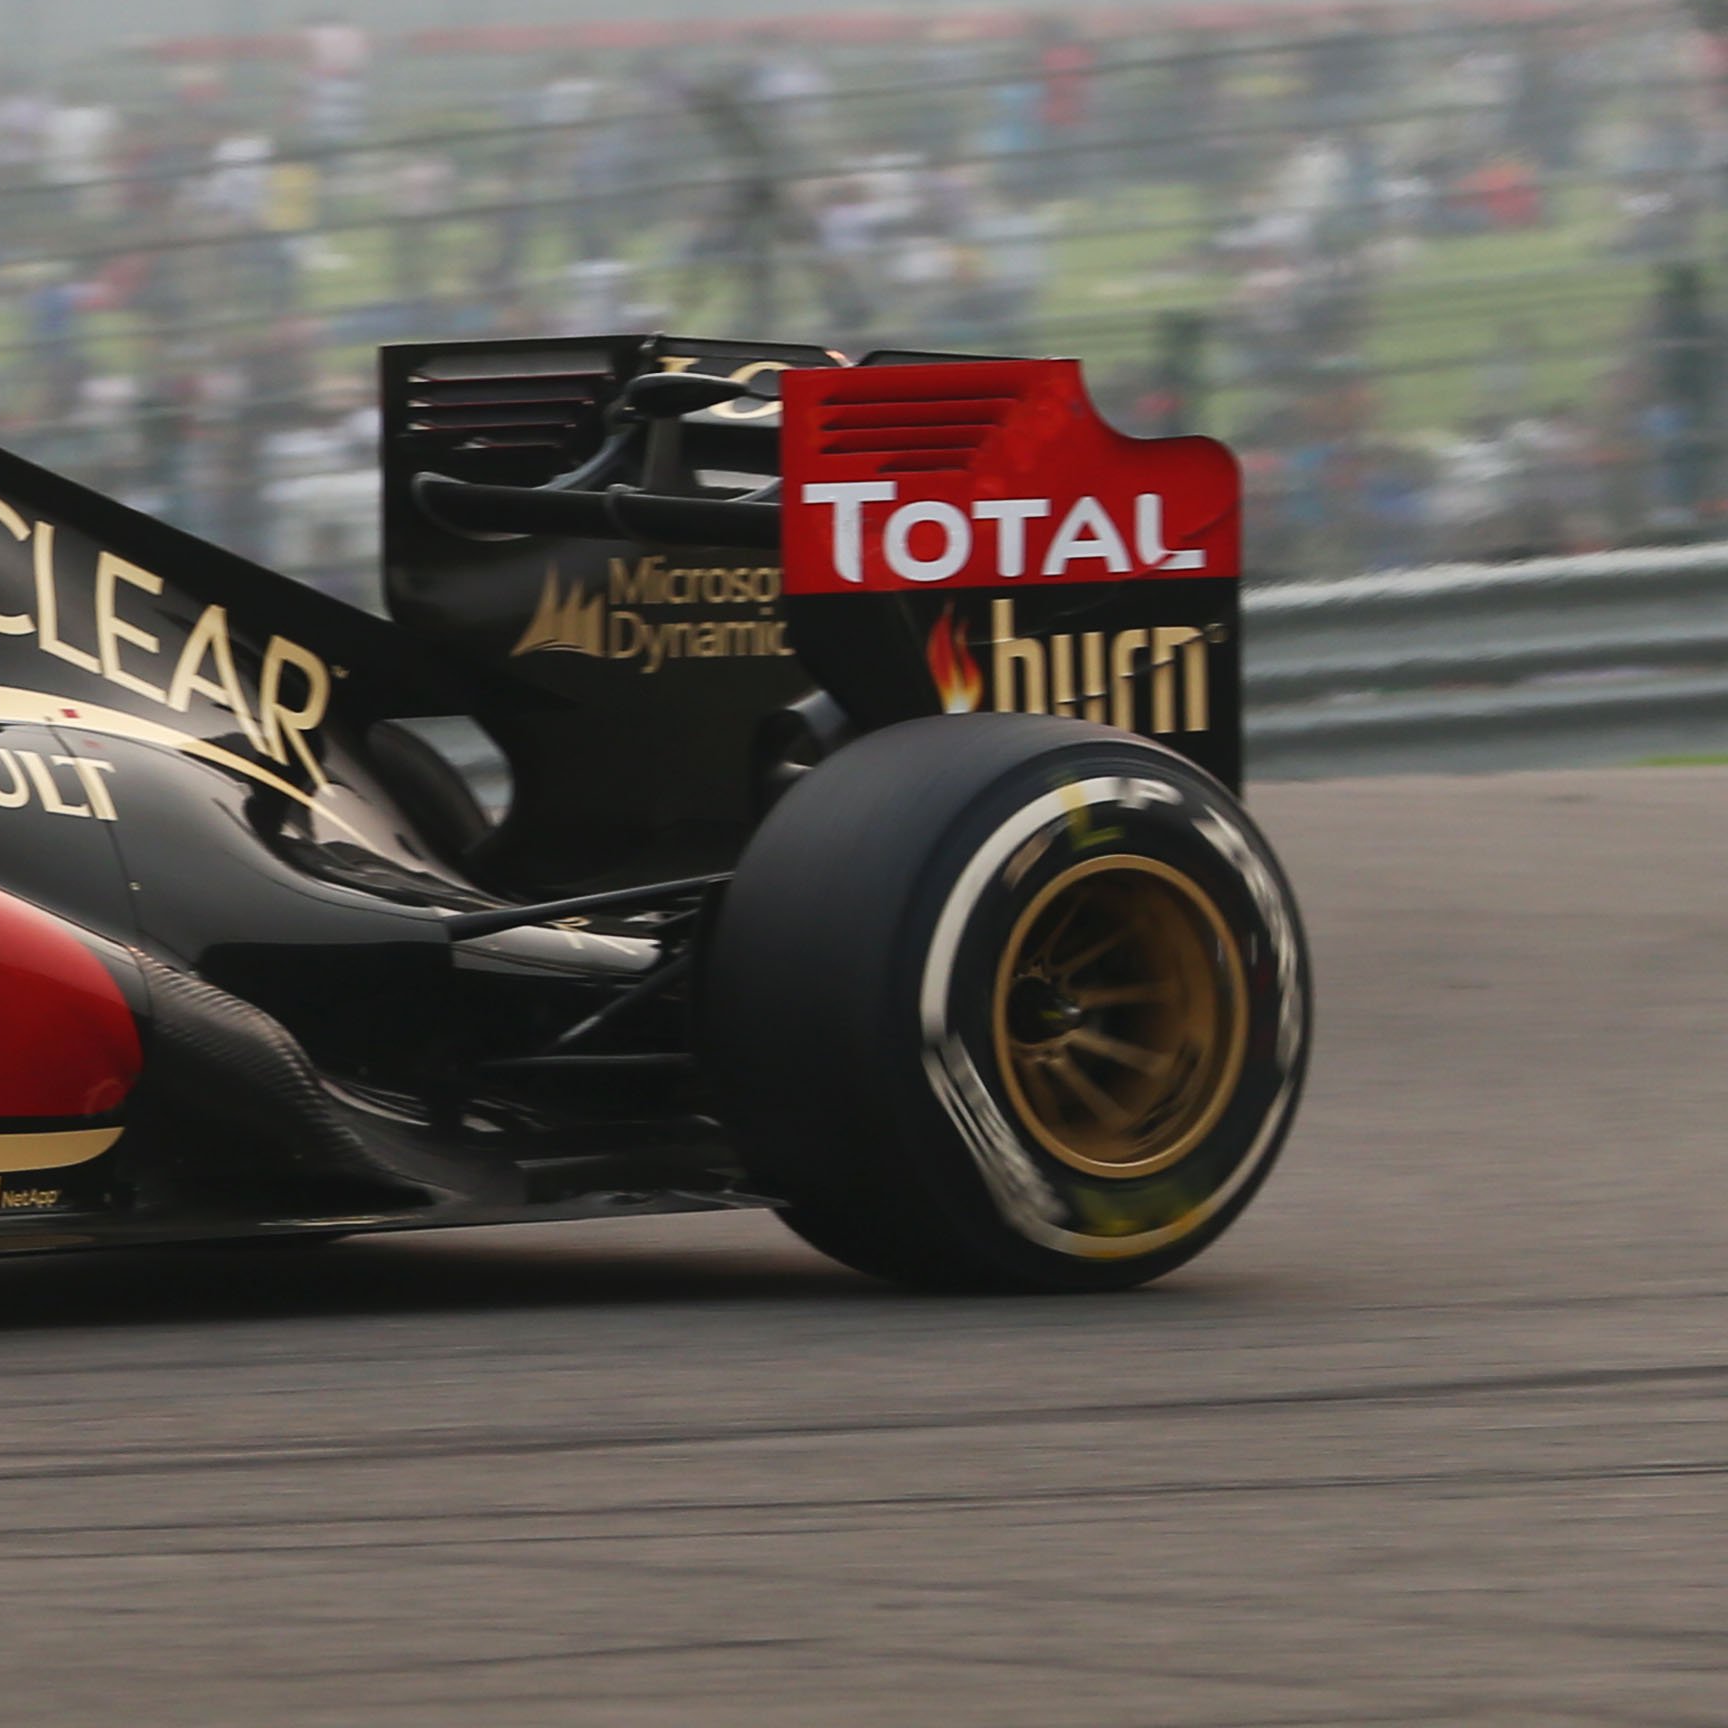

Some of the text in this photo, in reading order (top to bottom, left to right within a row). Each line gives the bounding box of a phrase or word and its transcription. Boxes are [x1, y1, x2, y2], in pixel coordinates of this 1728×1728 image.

[802, 480, 1207, 584] TOTAL
[607, 555, 783, 605] Microso
[607, 606, 797, 674] Dynamic
[1, 1189, 58, 1209] NetApp
